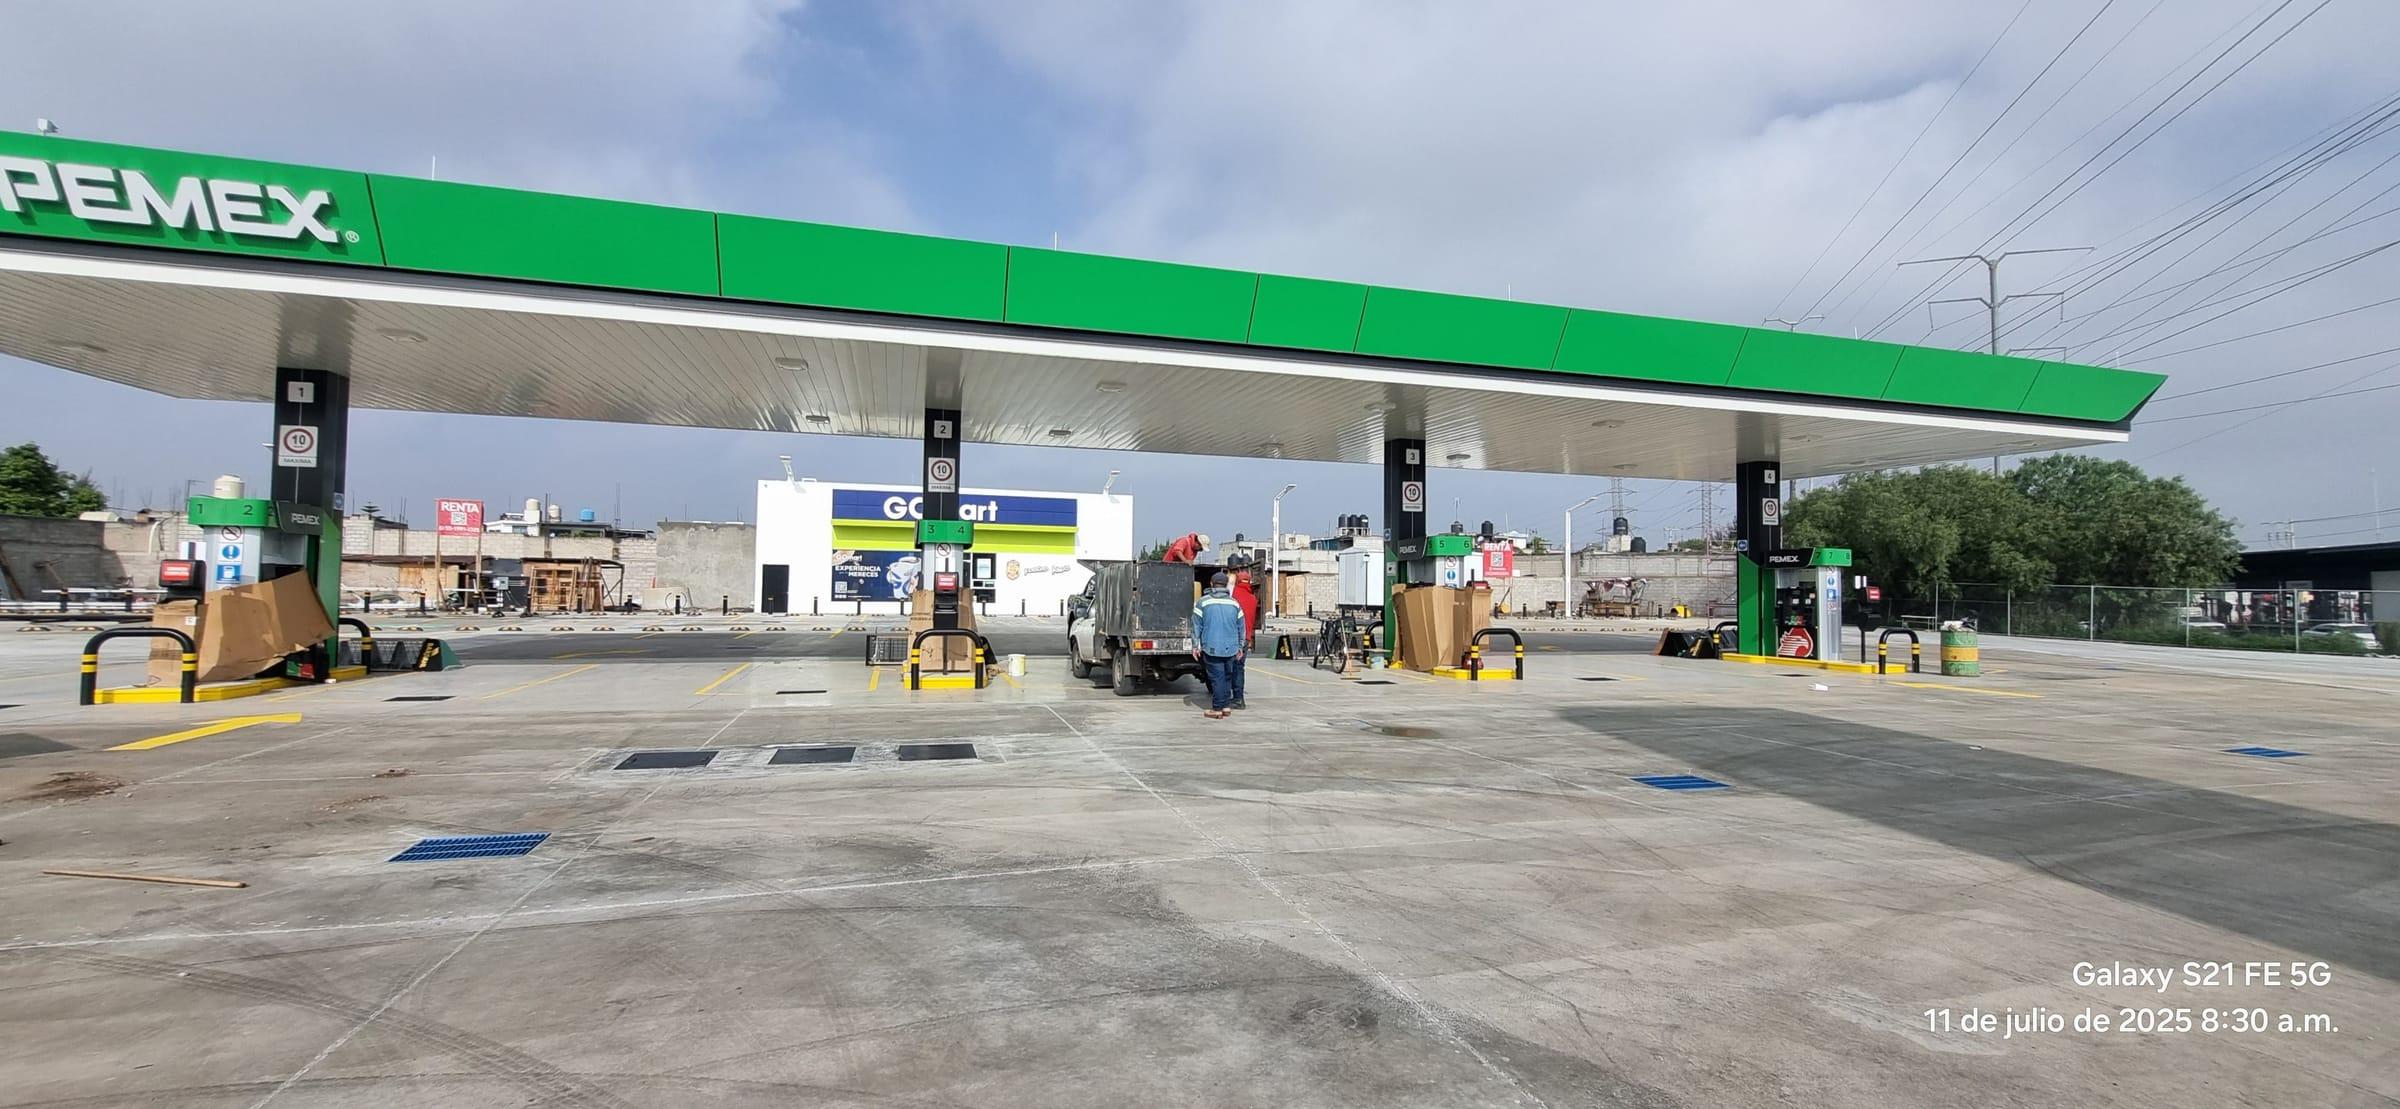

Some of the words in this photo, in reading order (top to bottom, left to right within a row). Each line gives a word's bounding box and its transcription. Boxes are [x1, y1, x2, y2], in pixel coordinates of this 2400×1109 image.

[0, 155, 339, 244] PEMEX
[298, 387, 304, 398] 1
[939, 424, 947, 434] 2
[291, 434, 307, 445] 10
[1410, 452, 1416, 461] 3
[936, 464, 948, 474] 10
[1408, 487, 1417, 496] 10
[197, 503, 204, 514] 1
[243, 505, 253, 516] 2
[441, 501, 480, 513] RENTA
[883, 496, 998, 521] GOart
[290, 512, 321, 526] PEMEX
[928, 524, 936, 534] 3
[956, 525, 966, 535] 4
[1439, 539, 1446, 548] 5
[1463, 539, 1470, 548] 6
[1484, 541, 1511, 552] RENTA
[1399, 545, 1417, 554] PEMEX
[1828, 551, 1834, 559] 7
[1768, 555, 1800, 563] PEMEX
